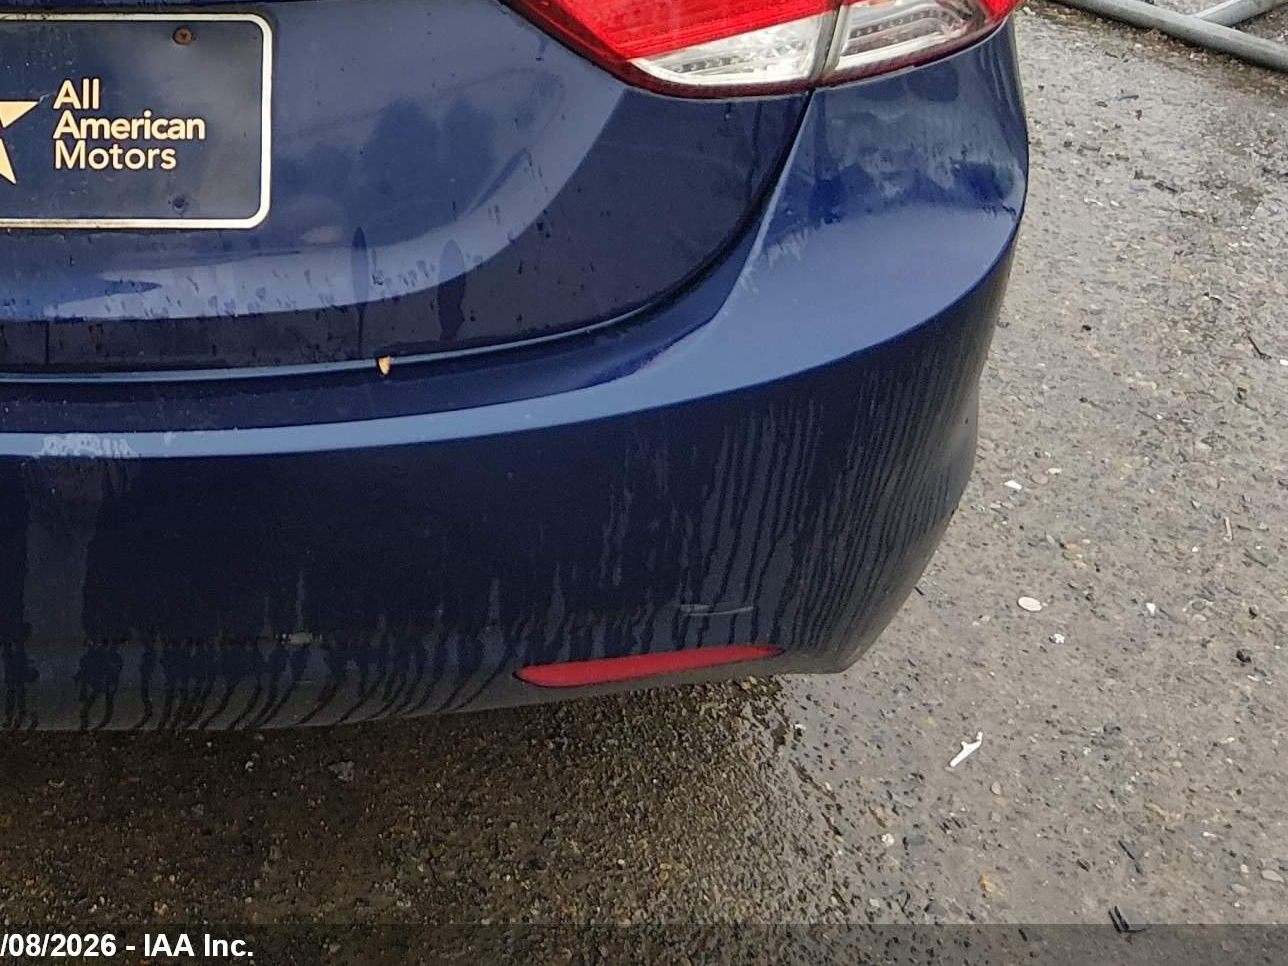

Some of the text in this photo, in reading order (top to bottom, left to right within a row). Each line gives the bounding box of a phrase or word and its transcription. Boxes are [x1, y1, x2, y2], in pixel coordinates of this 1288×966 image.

[53, 78, 100, 110] All
[53, 110, 205, 140] American
[55, 140, 177, 170] Motors
